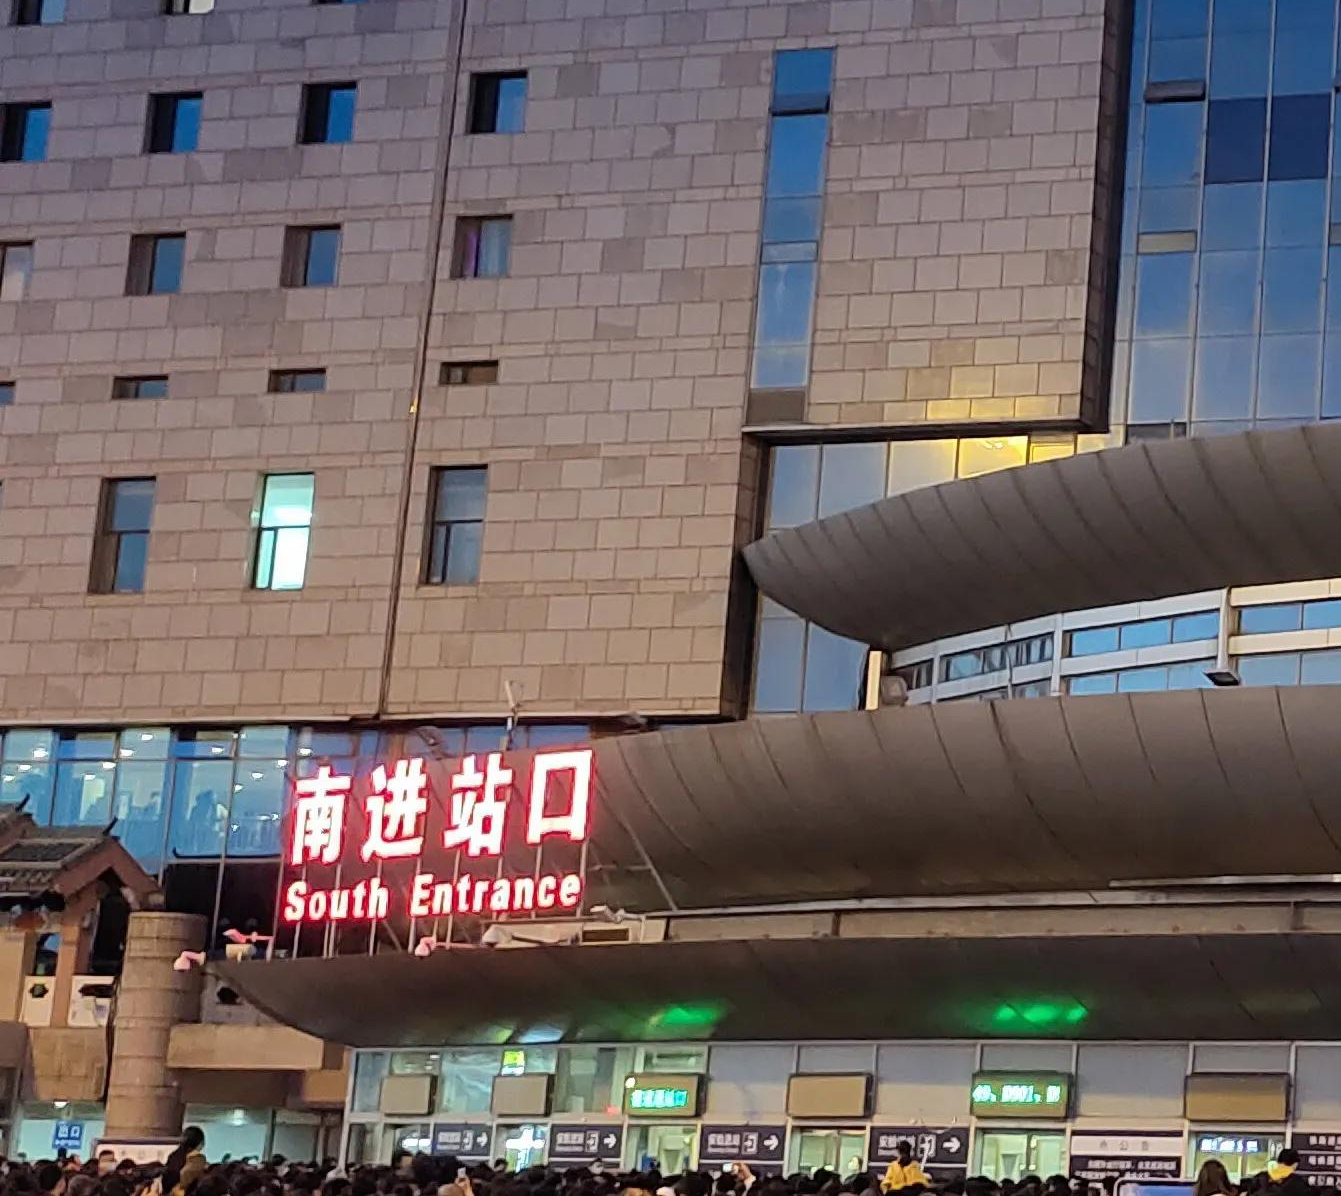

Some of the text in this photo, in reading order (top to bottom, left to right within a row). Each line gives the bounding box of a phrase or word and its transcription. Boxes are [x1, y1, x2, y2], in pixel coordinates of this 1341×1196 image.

[291, 749, 594, 866] 南进站口
[283, 871, 582, 922] South Entrance
